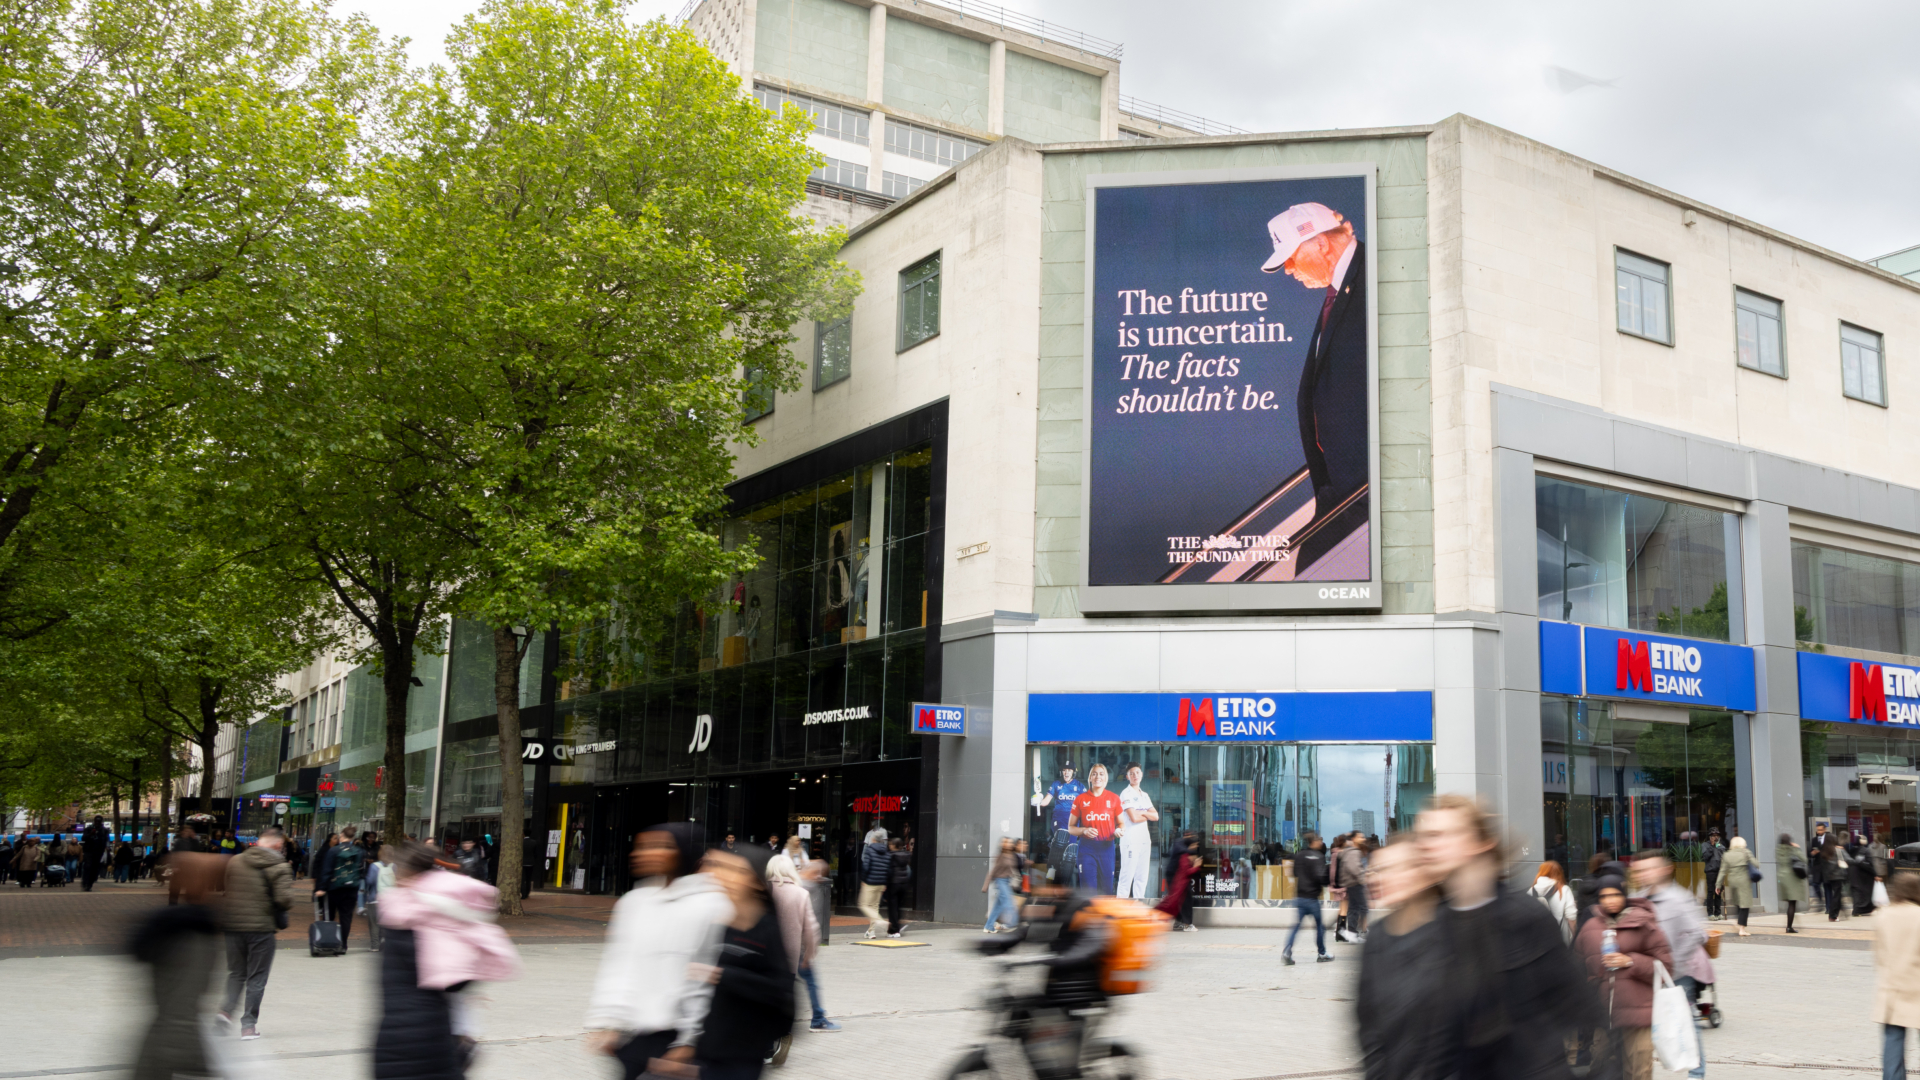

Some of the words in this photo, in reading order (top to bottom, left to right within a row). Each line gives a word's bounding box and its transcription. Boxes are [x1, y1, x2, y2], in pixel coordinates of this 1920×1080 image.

[1118, 289, 1172, 315] The
[1179, 287, 1268, 314] future
[1118, 321, 1140, 347] is
[1147, 316, 1293, 346] uncertain.
[1120, 354, 1170, 380] The
[1171, 352, 1241, 385] facts
[1242, 384, 1280, 411] be.
[1167, 537, 1201, 549] THE
[1240, 535, 1290, 548] TIMES
[1167, 551, 1194, 563] THE
[1195, 550, 1247, 562] SUNDAY
[1248, 549, 1290, 562] TIMES
[1318, 588, 1370, 600] OCEAN
[1616, 638, 1702, 692] METRO
[1654, 674, 1703, 698] BANK
[802, 705, 870, 726] JDSPORTS.CO.UK
[918, 708, 962, 729] METRO
[1176, 697, 1276, 736] METRO
[1886, 701, 1920, 726] BAN
[688, 714, 712, 754] JD
[937, 721, 962, 730] BANK
[1220, 720, 1276, 736] BANK
[522, 743, 544, 759] JD
[575, 744, 587, 754] KING
[592, 740, 616, 752] TRAINERS
[1058, 793, 1076, 801] cinch
[1085, 811, 1111, 821] cinch
